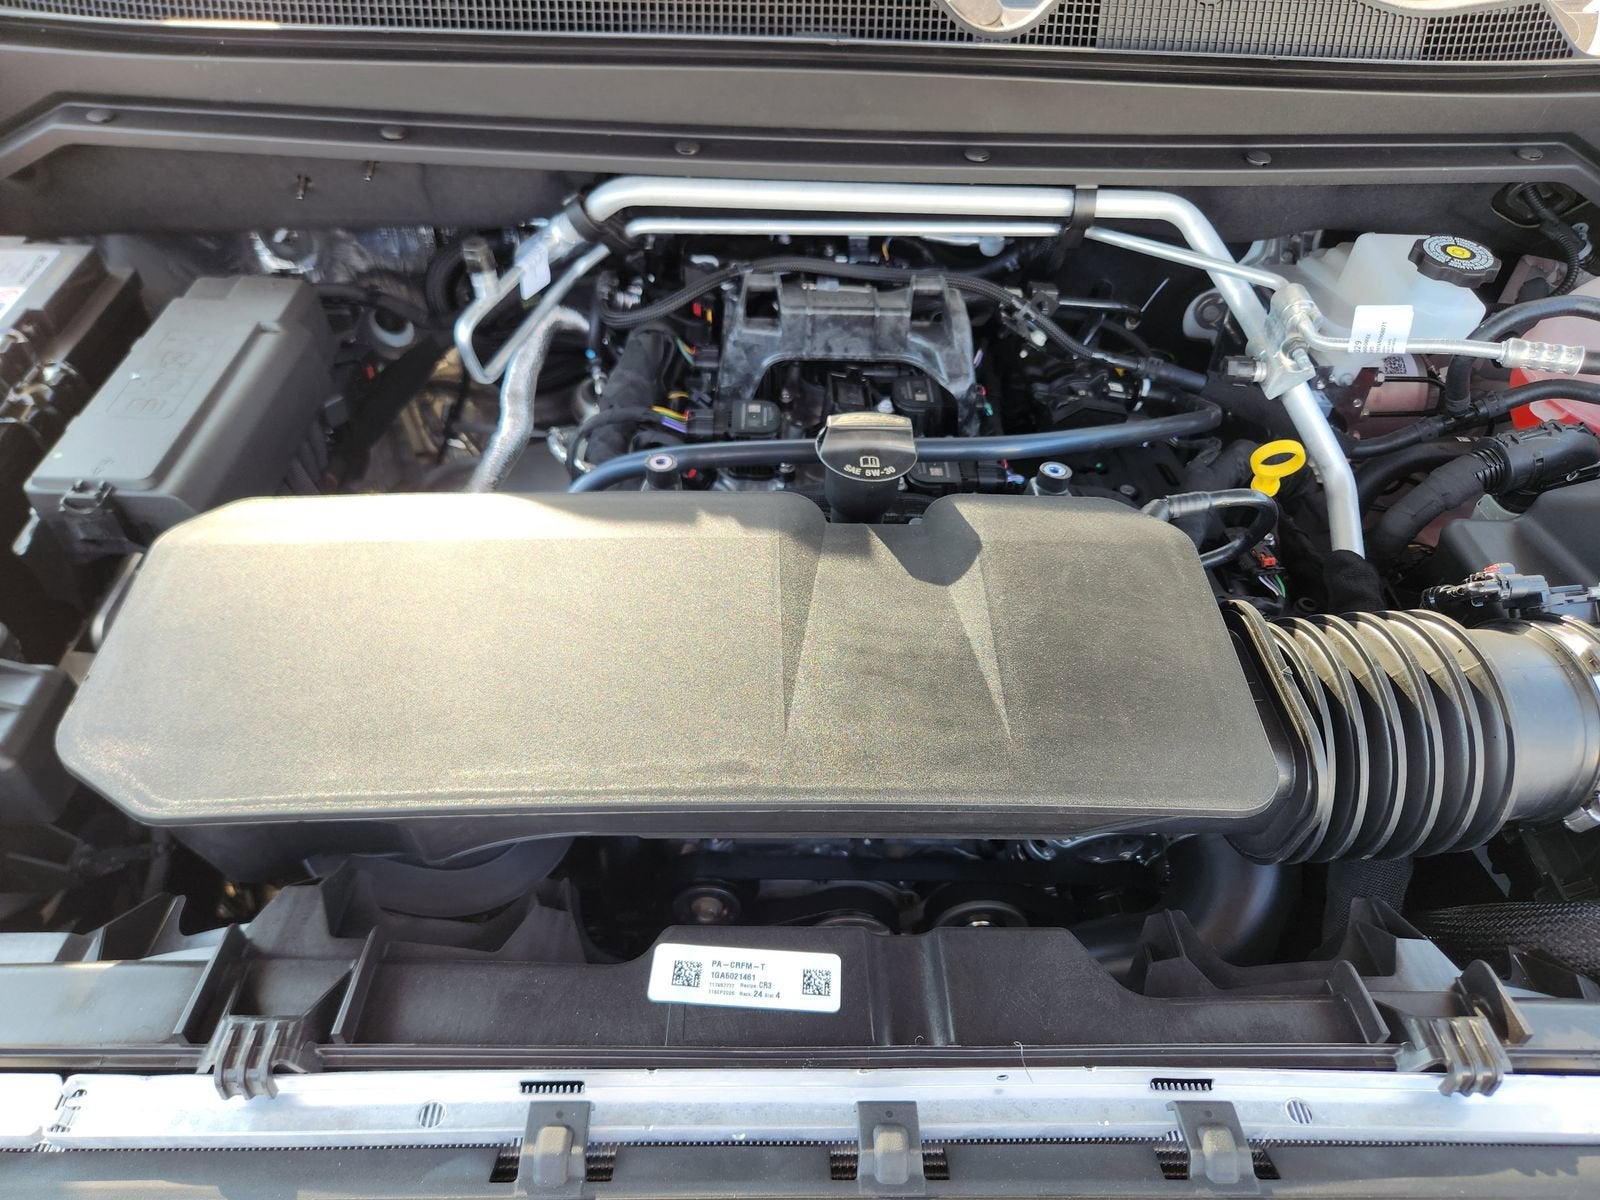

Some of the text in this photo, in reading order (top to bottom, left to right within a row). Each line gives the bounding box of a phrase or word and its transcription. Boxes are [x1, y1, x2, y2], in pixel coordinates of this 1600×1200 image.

[844, 464, 896, 476] SAE 5W-30
[758, 982, 772, 990] CR3
